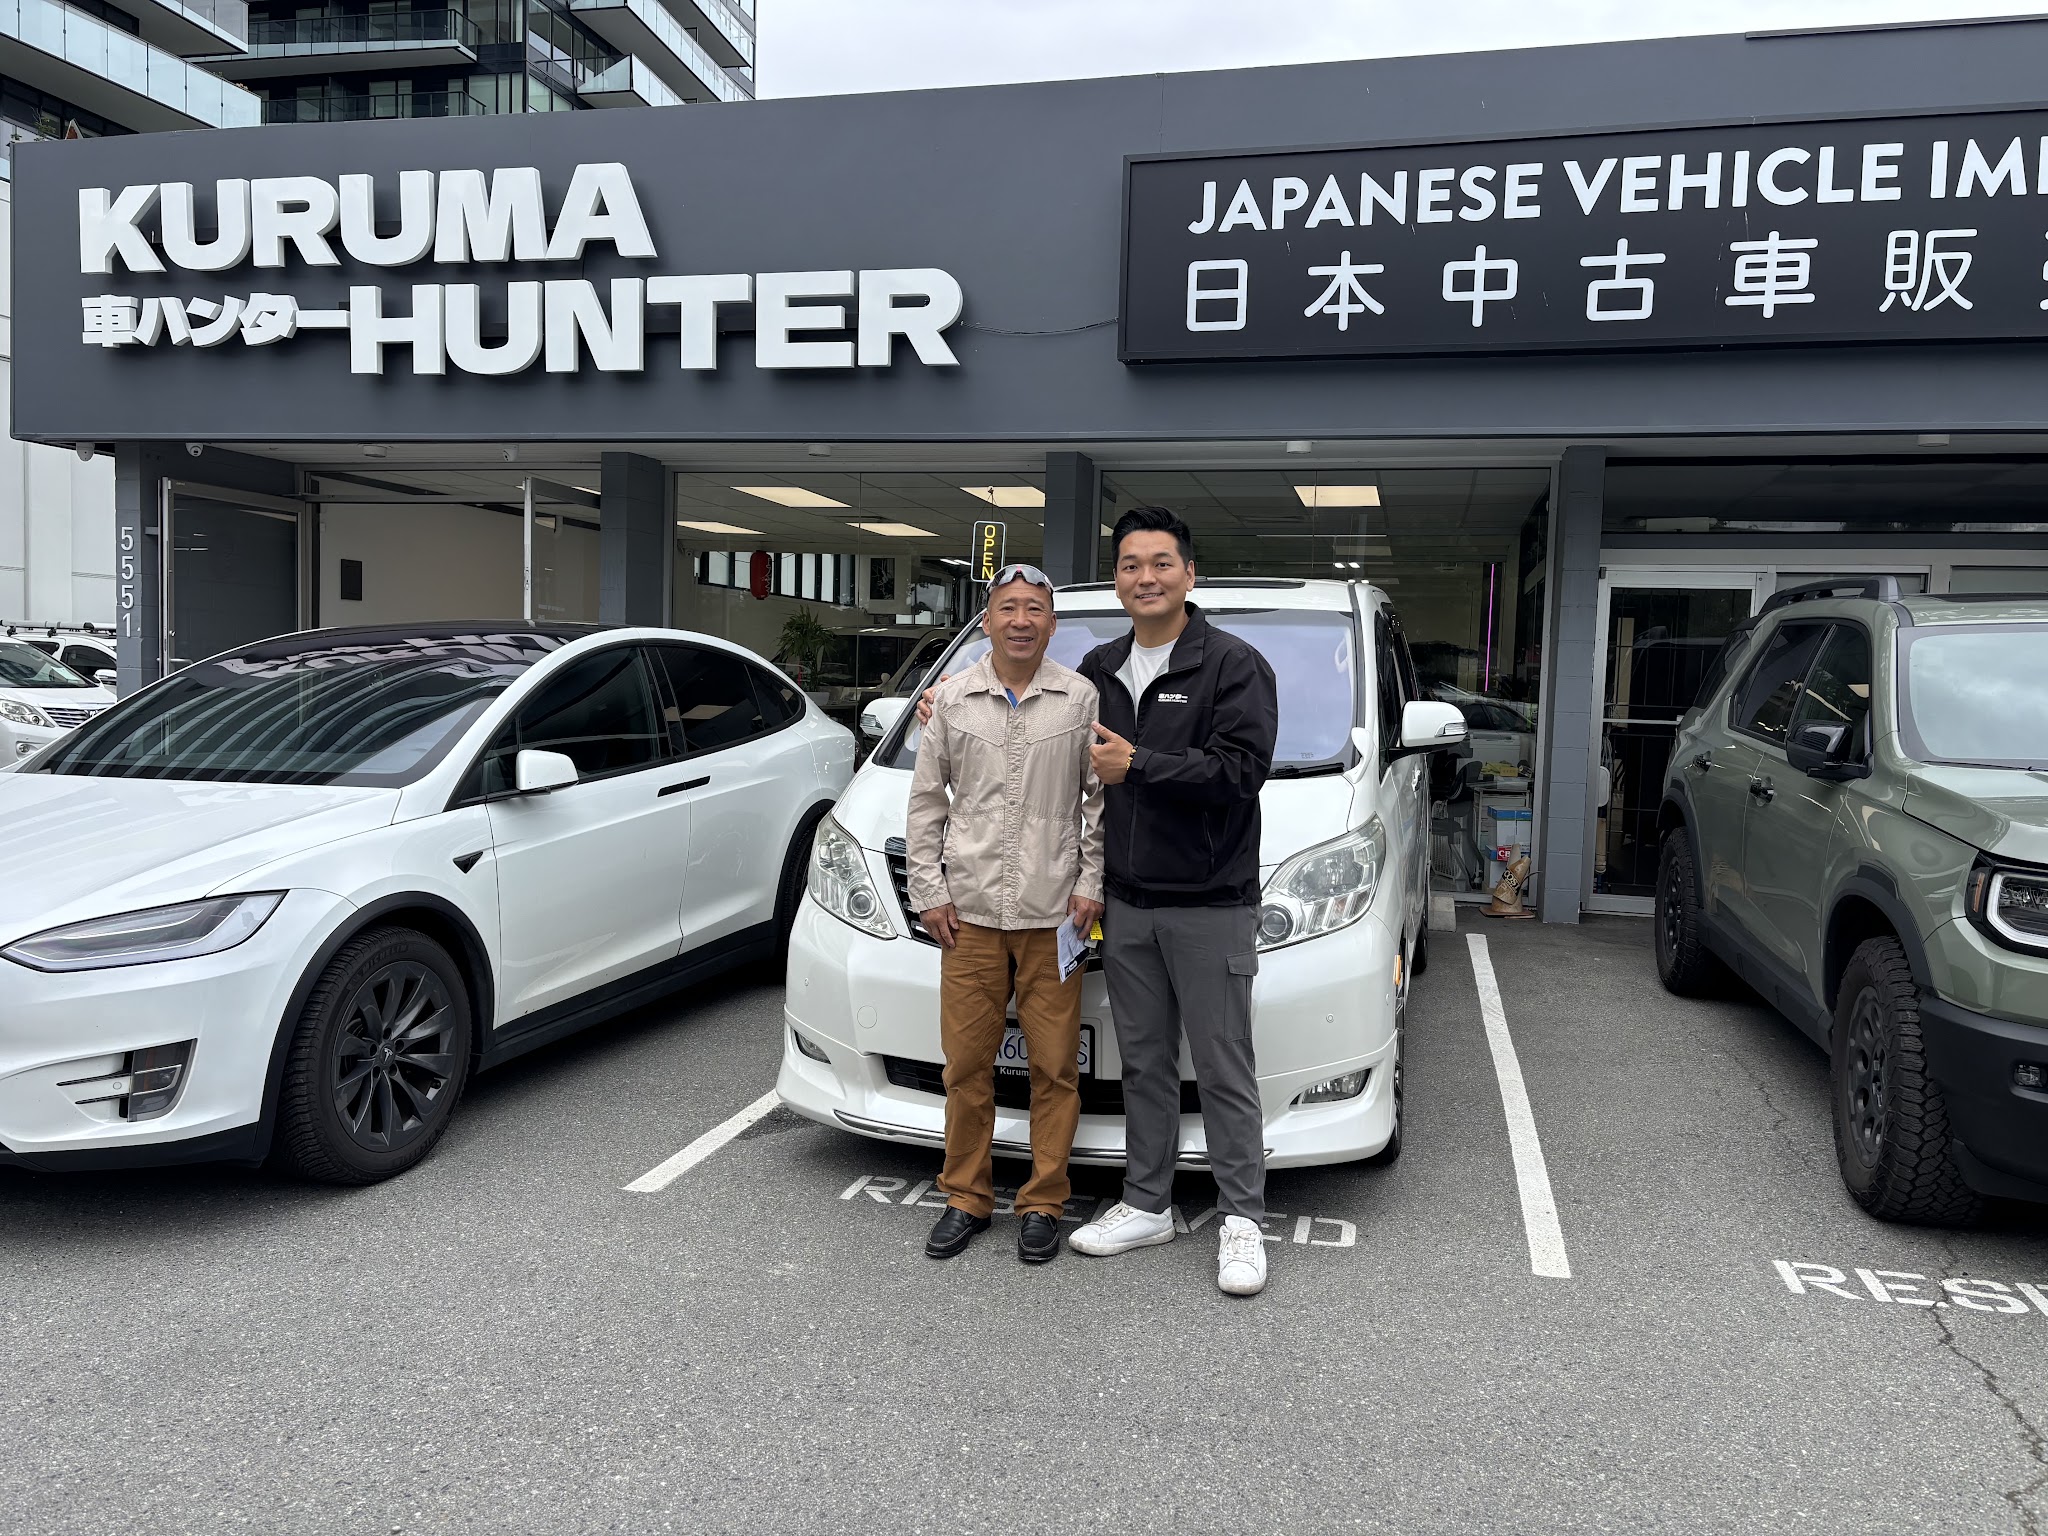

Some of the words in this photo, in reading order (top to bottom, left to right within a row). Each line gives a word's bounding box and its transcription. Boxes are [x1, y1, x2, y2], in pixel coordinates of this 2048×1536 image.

[79, 162, 658, 274] KURUMA
[1187, 162, 1543, 235] JAPANESE
[1562, 142, 1904, 216] VEHICLE
[82, 292, 351, 348] 車ハンター
[349, 268, 963, 376] HUNTER
[120, 526, 134, 638] 5551
[981, 524, 996, 581] OPEN
[999, 1066, 1030, 1077] Kurum
